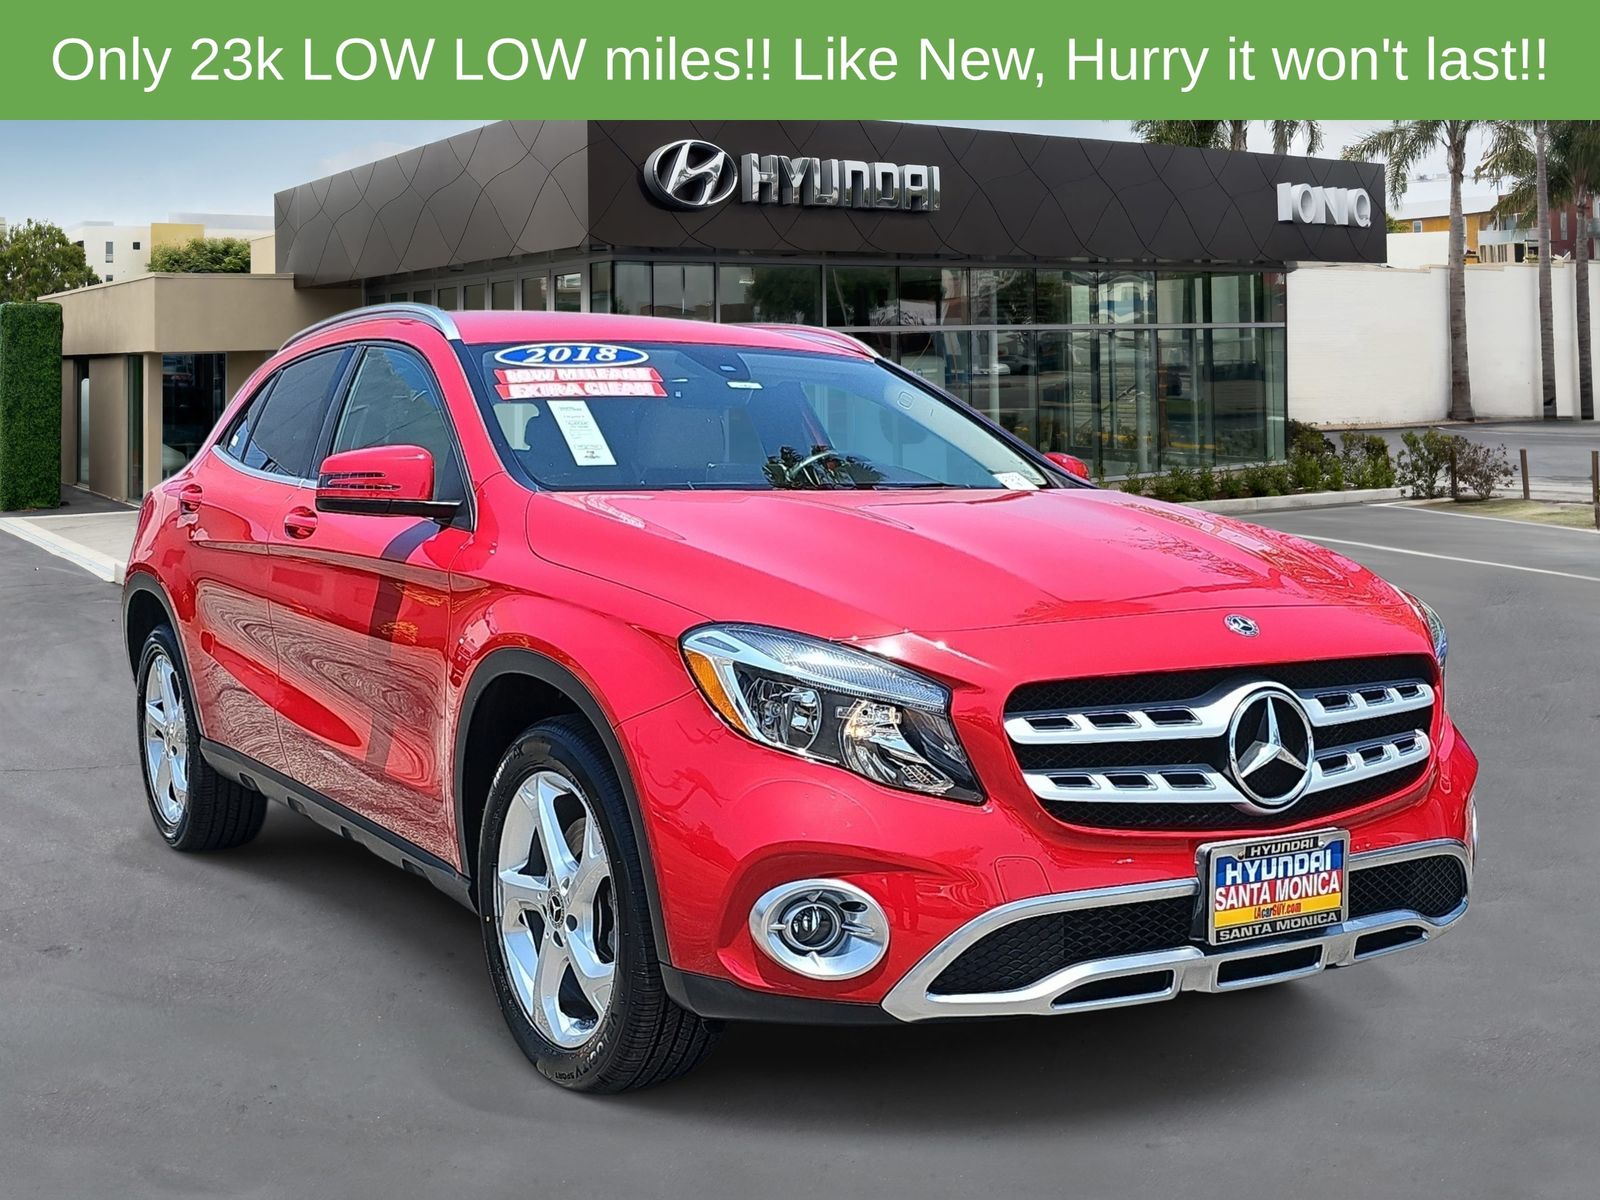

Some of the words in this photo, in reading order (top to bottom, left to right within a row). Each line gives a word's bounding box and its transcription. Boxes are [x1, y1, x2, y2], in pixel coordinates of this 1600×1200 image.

[741, 152, 941, 211] HYUNDAI
[1276, 182, 1372, 228] IONIQ
[524, 347, 618, 362] 2018
[1250, 838, 1314, 857] HYUNDAI
[1225, 849, 1332, 886] HYUNDAI
[1215, 882, 1272, 911] SANTA
[1275, 871, 1340, 902] MONICA
[1219, 924, 1272, 941] SANTA
[1276, 912, 1338, 931] MONICA
